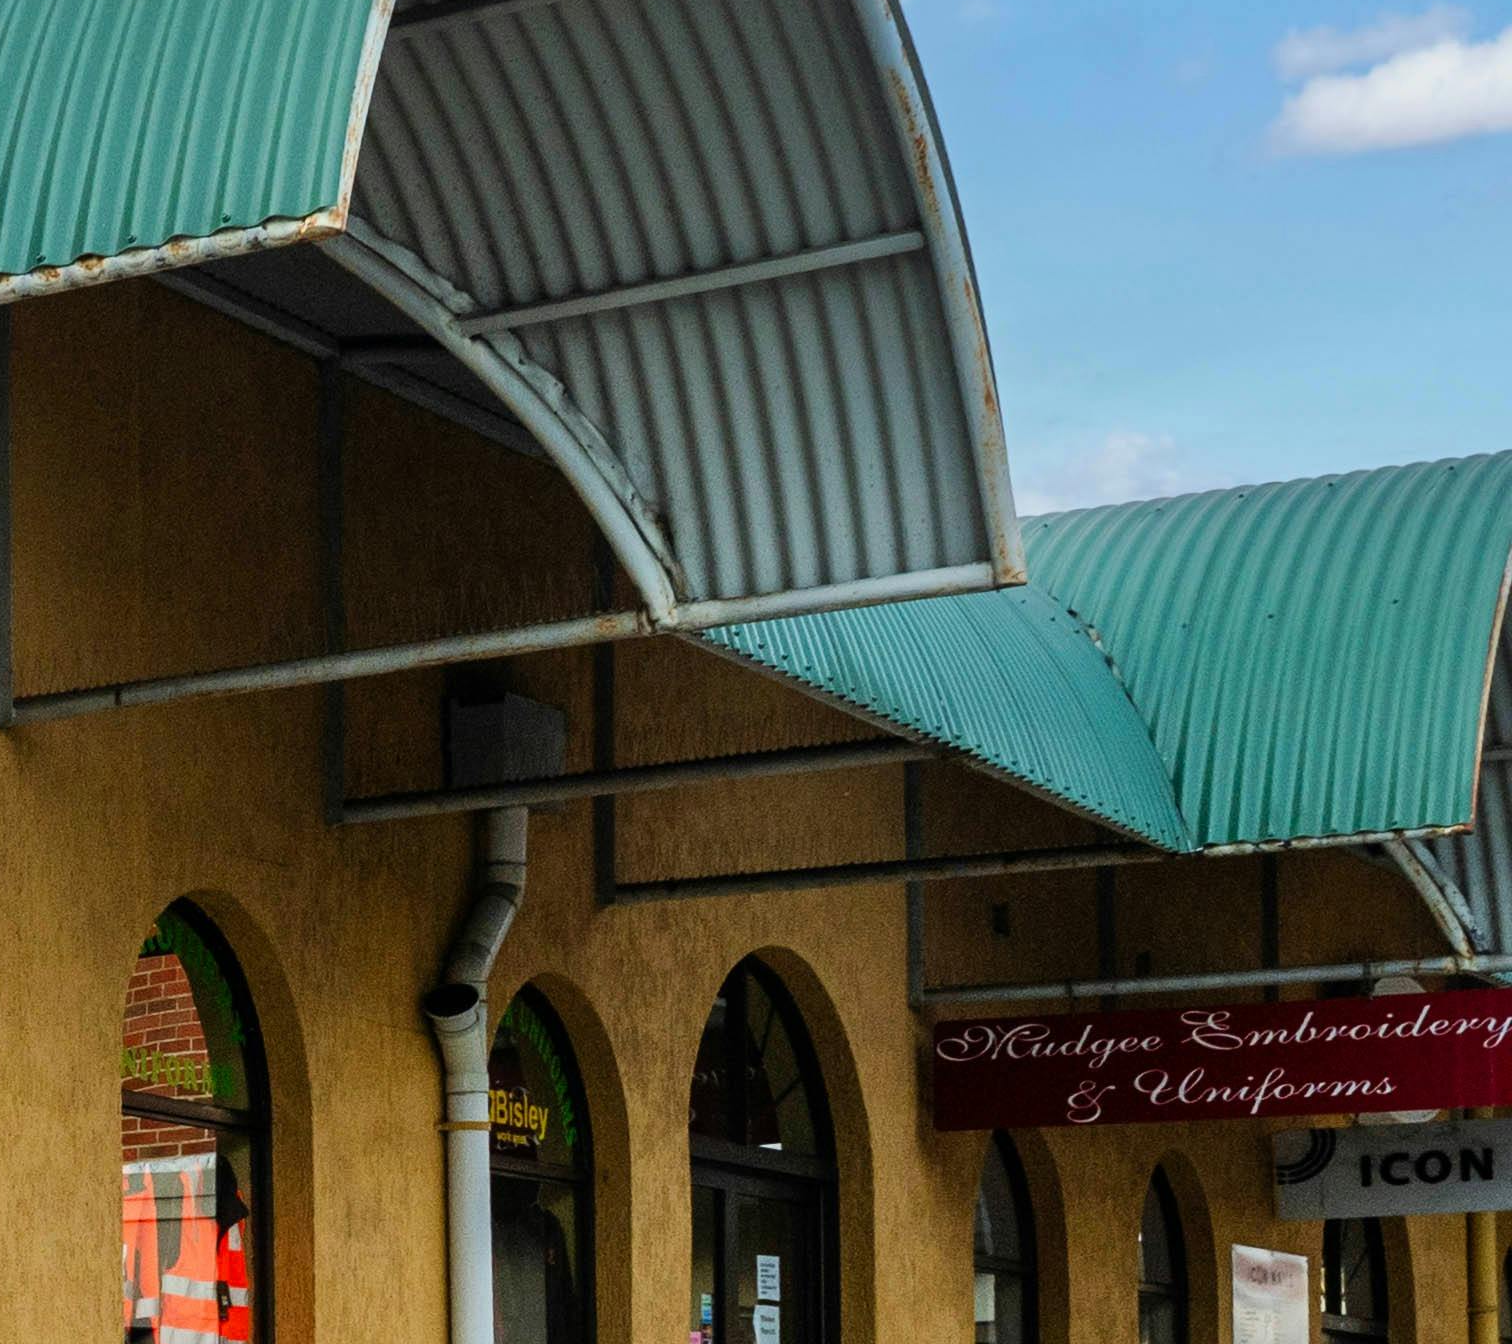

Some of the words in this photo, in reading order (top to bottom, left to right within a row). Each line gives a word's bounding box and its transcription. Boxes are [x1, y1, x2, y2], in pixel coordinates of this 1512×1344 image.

[936, 1023, 1164, 1069] Mudgee
[1180, 1004, 1512, 1051] Embroidery
[496, 1089, 549, 1141] Bisley
[1067, 1079, 1116, 1124] &
[1133, 1067, 1398, 1115] Uniforms
[1360, 1147, 1495, 1188] ICON
